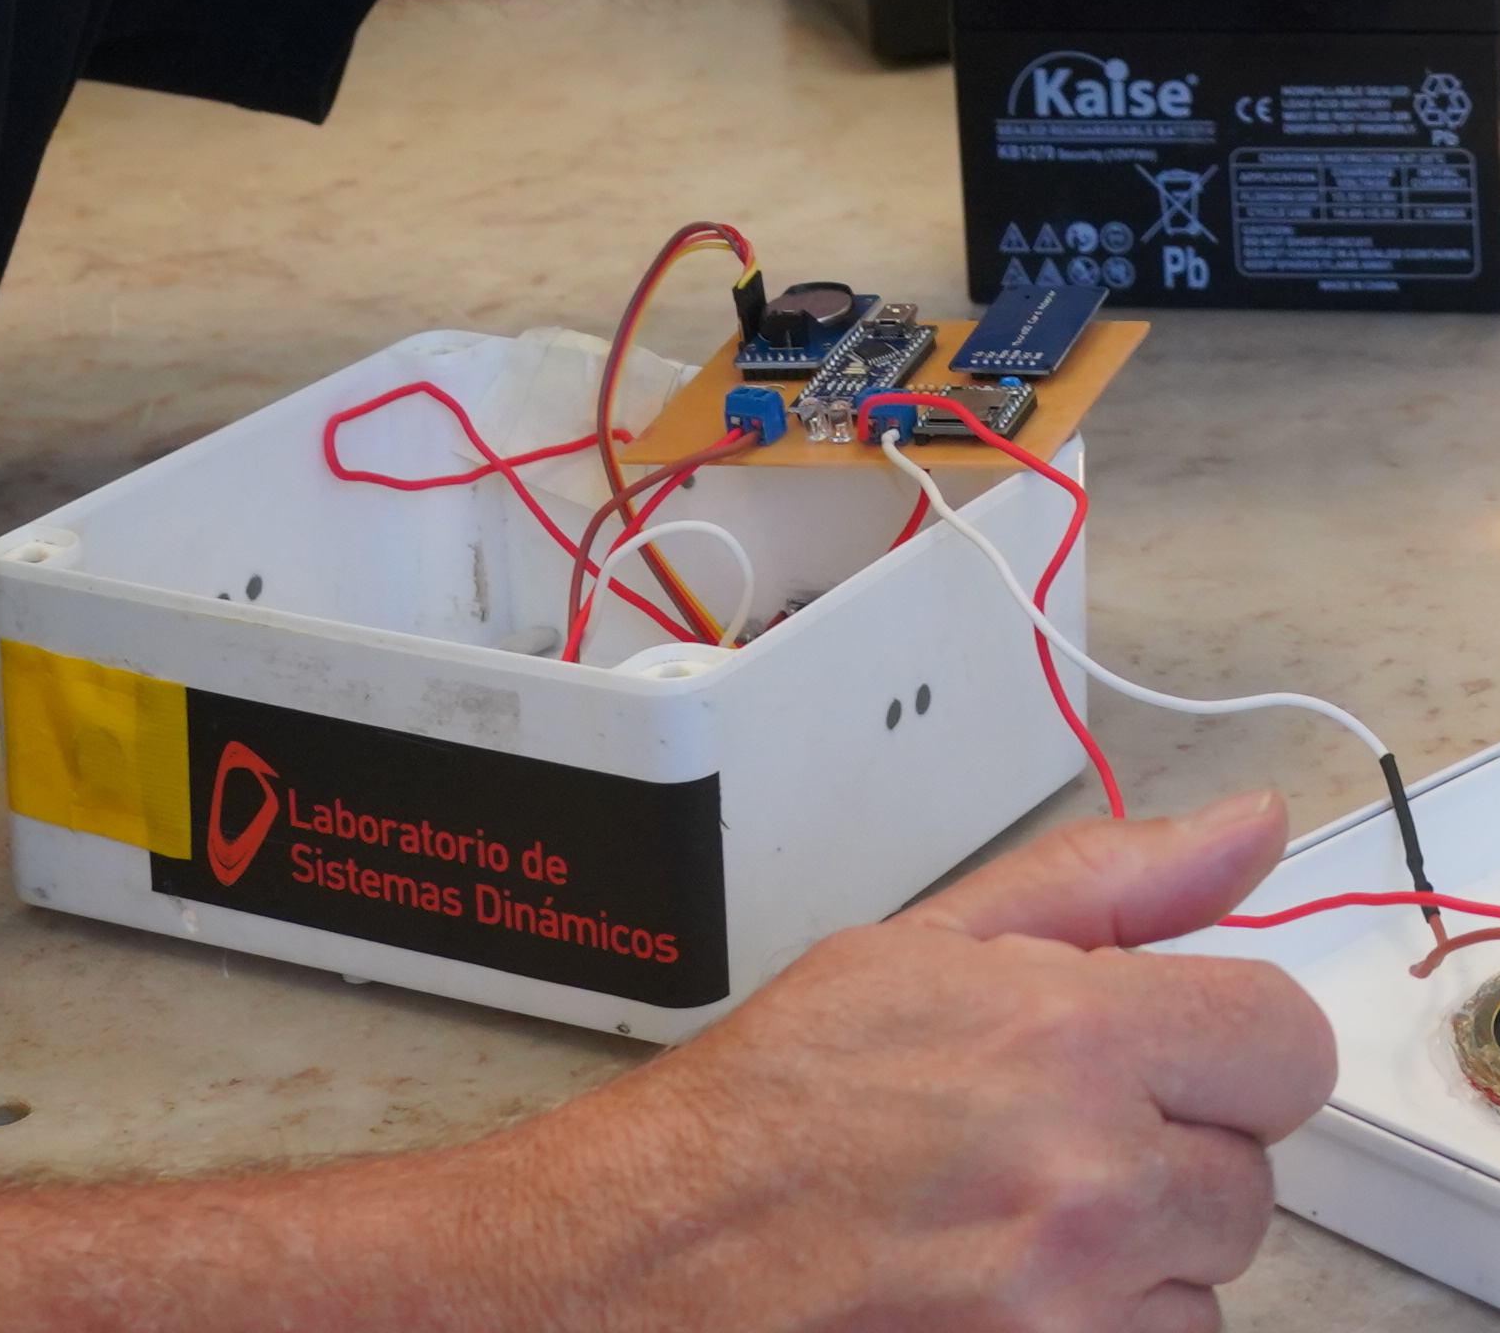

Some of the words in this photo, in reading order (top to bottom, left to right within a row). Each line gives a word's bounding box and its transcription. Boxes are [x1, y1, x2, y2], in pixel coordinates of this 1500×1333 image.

[1033, 58, 1195, 119] Kaise
[1235, 96, 1273, 123] CE
[1162, 245, 1211, 289] Pb
[287, 788, 509, 872] Laboratorio
[521, 841, 569, 885] de
[291, 843, 463, 917] Sistemas
[475, 883, 679, 963] Dinámicos
